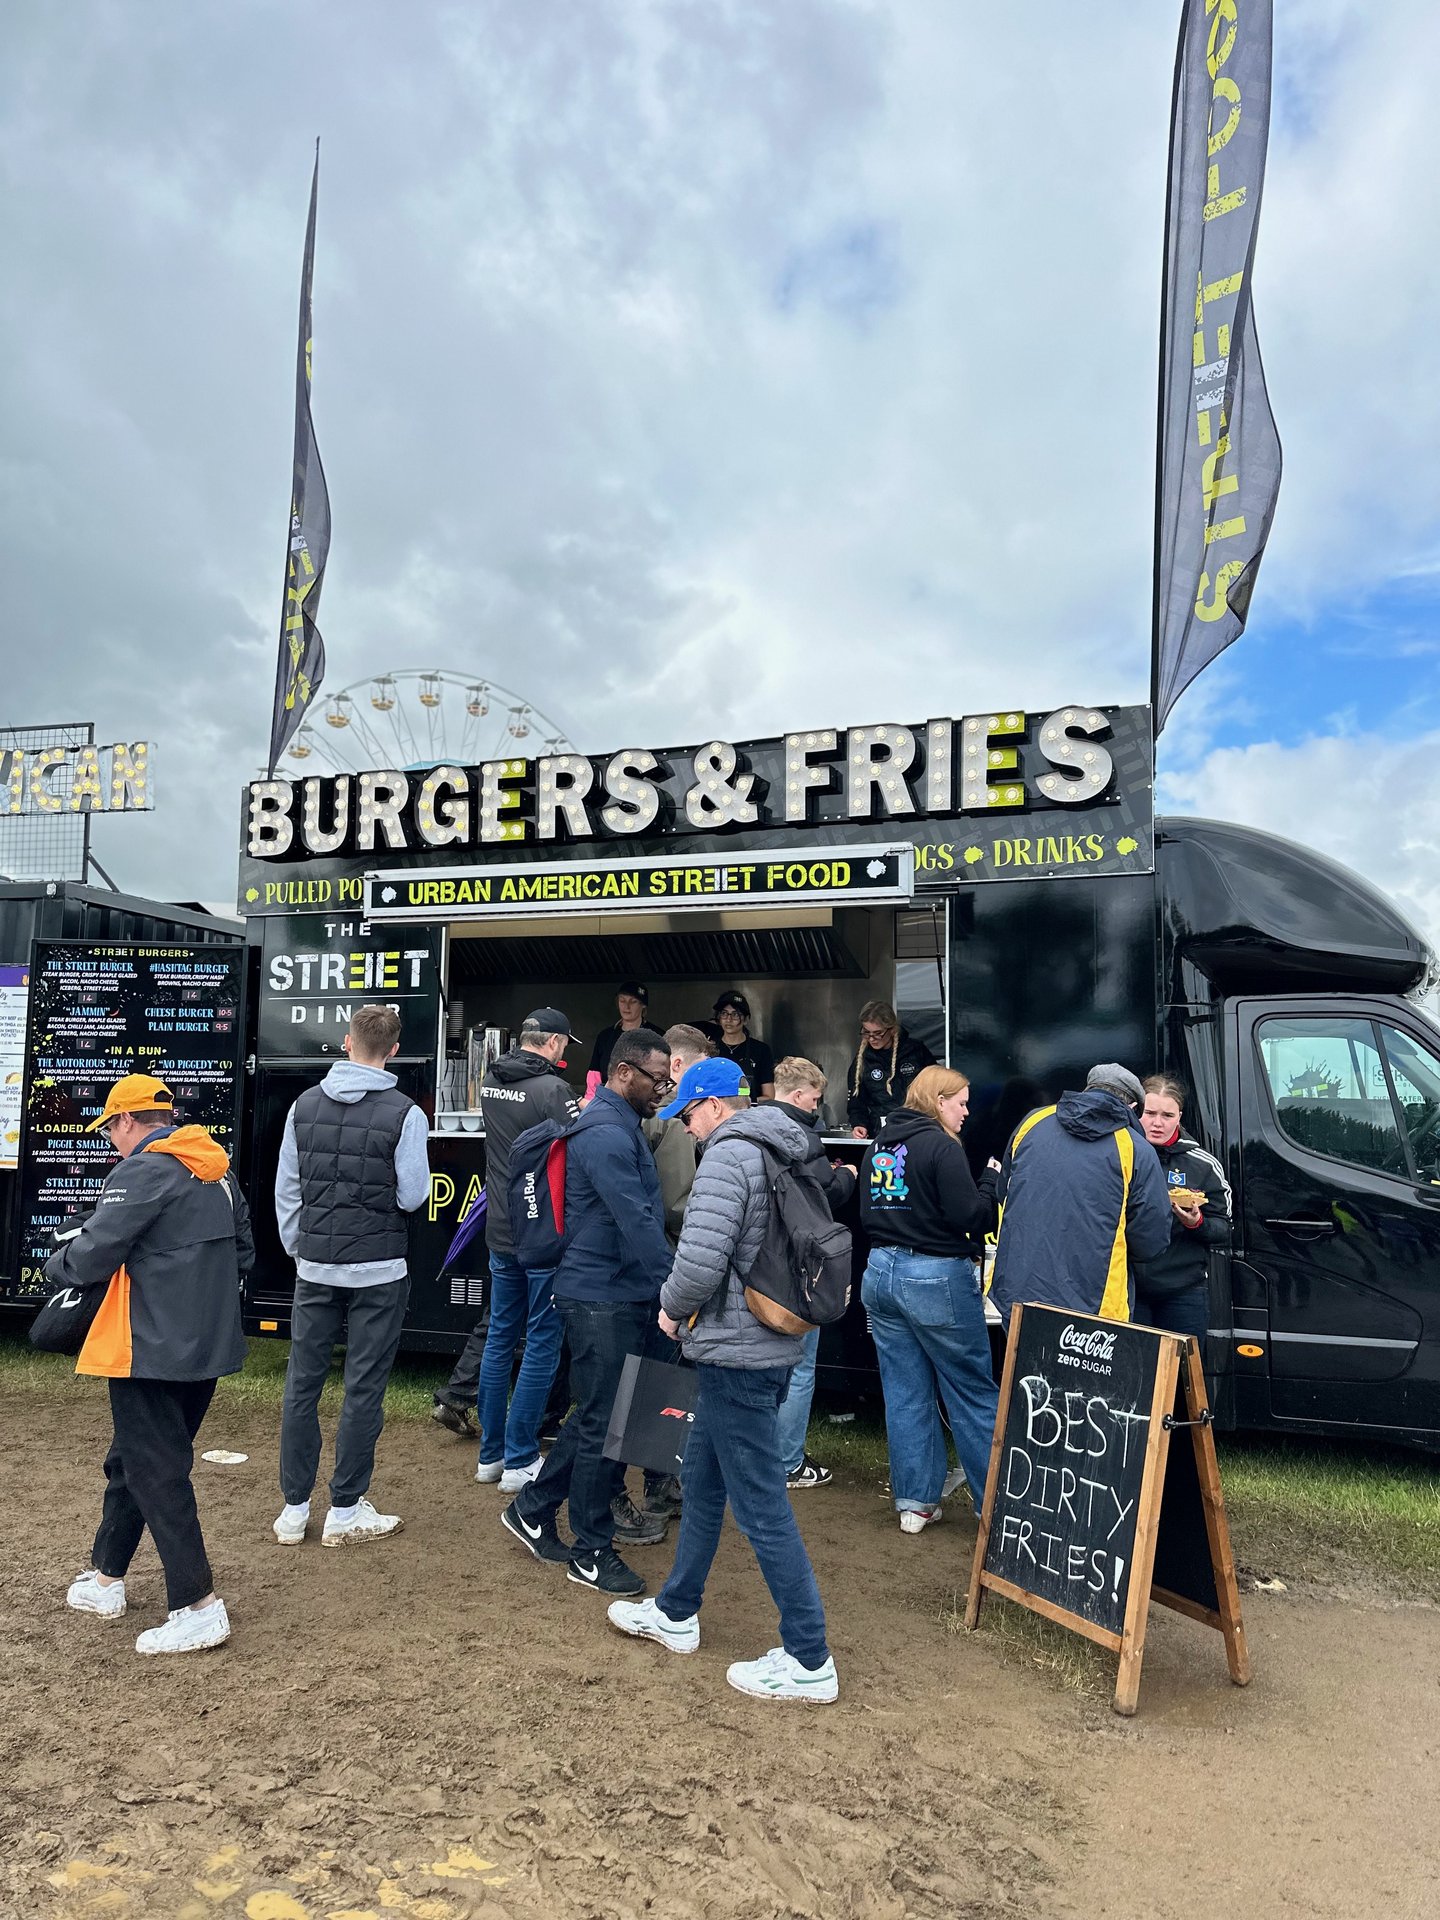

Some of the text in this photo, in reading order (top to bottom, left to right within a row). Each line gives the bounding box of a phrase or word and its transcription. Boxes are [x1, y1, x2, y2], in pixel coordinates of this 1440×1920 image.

[1202, 0, 1246, 223] FOO
[0, 742, 148, 813] ICAN
[249, 706, 1114, 857] BURGERS & FRIES
[993, 834, 1105, 867] DRINKS
[408, 861, 851, 905] URBAN AMERICAN STREET FOOD
[265, 878, 363, 905] PULLED PO
[324, 922, 372, 937] THE
[94, 948, 189, 958] STREET BURGERS
[46, 961, 134, 972] THE STREET BURGER
[150, 963, 230, 974] #HASHTAG BURGER
[269, 950, 429, 991] STREET
[145, 1008, 214, 1018] CHEESE BURGER
[291, 1004, 400, 1024] DIN
[148, 1022, 209, 1032] PLAIN BURGER
[111, 1046, 162, 1055] IN A BUN
[36, 1058, 54, 1067] THE
[56, 1058, 106, 1068] NOTORIOUS
[220, 1060, 232, 1069] (V)
[480, 1086, 526, 1102] PETRONAS
[36, 1124, 84, 1132] LOADED
[48, 1139, 111, 1149] PIGGIE SMALLS
[46, 1178, 80, 1188] STREET
[31, 1216, 60, 1224] NACHO
[1060, 1324, 1118, 1360] Coca-Cola
[1058, 1354, 1112, 1376] zero SUGAR
[1018, 1375, 1151, 1468] BEST
[1005, 1446, 1134, 1541] DIRTY
[1000, 1515, 1125, 1603] FRIES!
